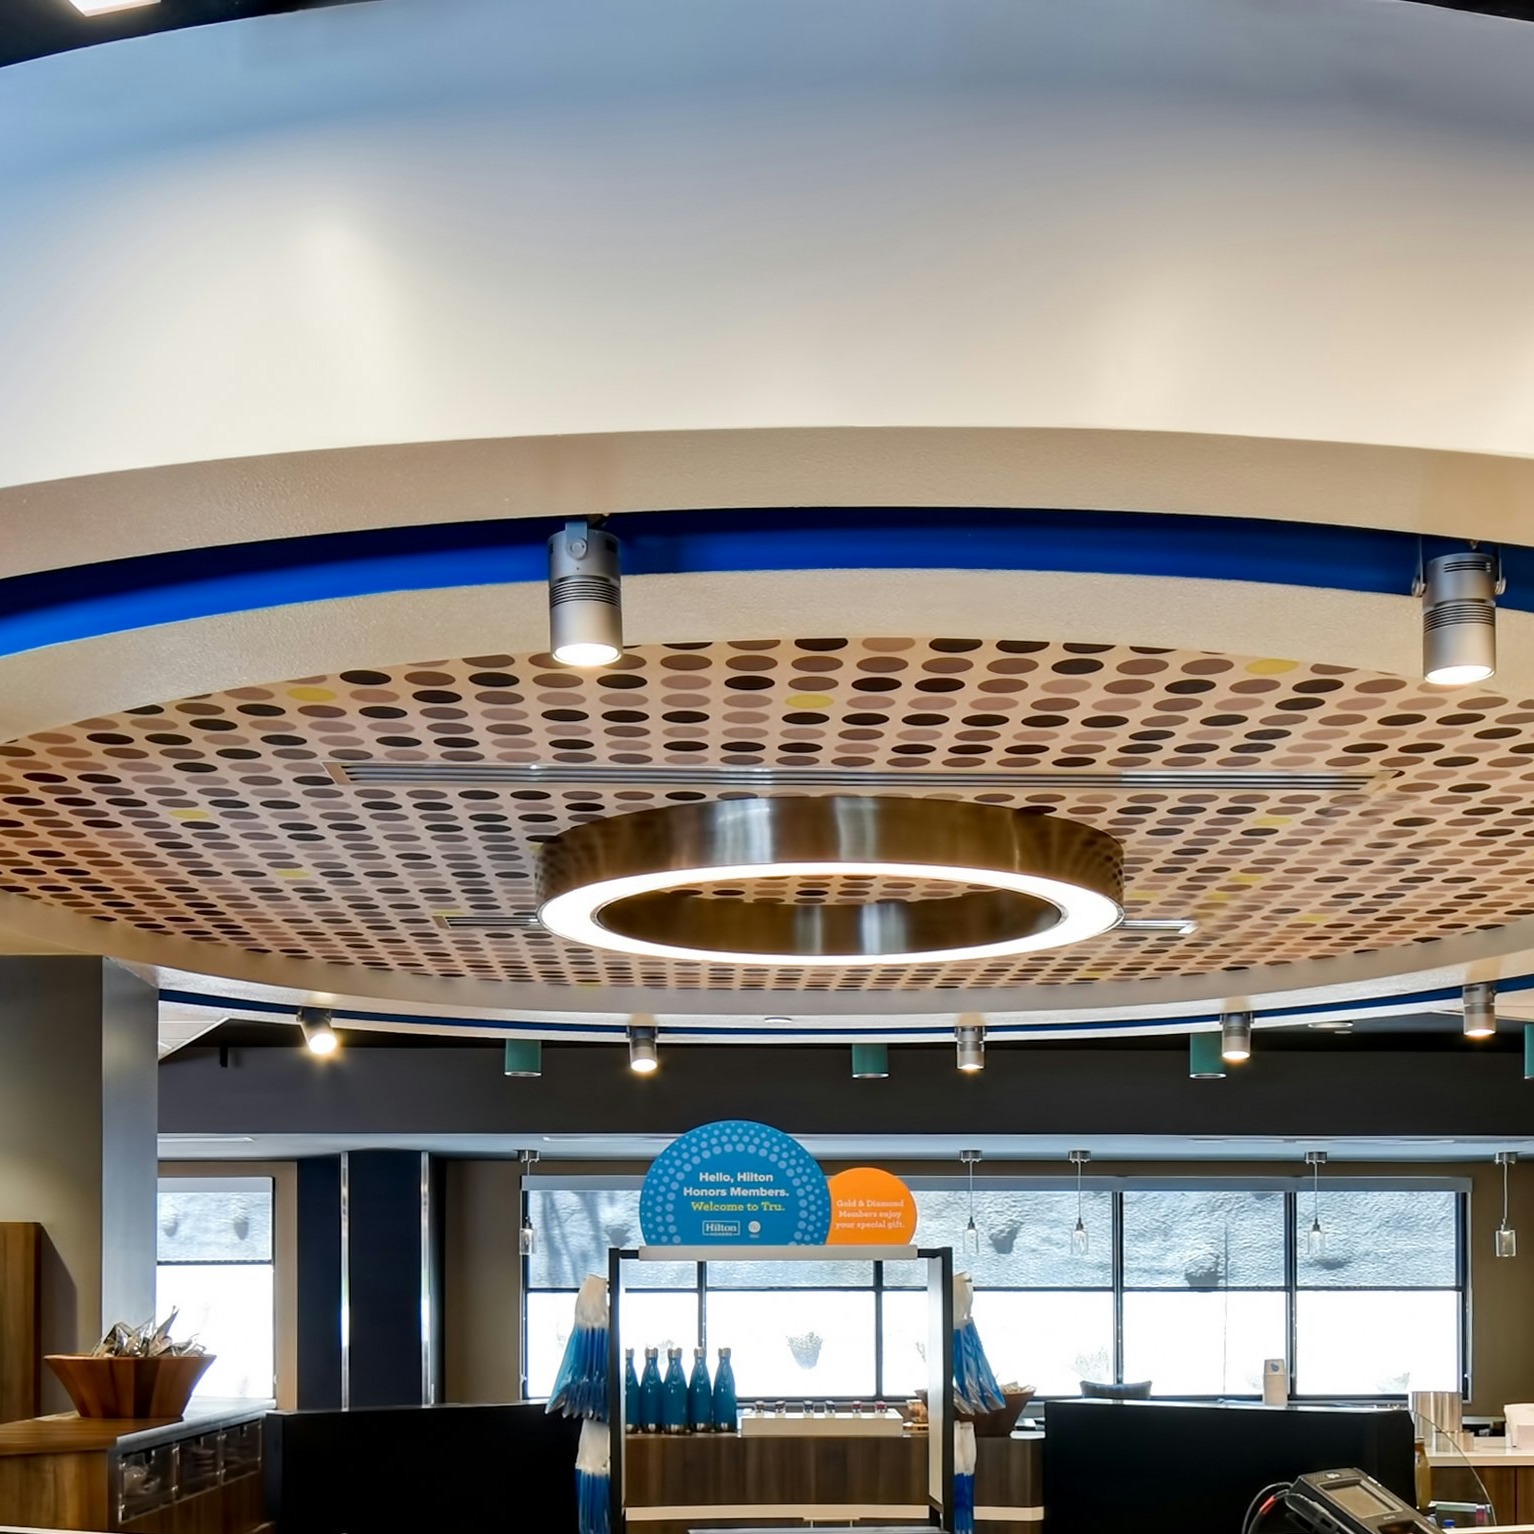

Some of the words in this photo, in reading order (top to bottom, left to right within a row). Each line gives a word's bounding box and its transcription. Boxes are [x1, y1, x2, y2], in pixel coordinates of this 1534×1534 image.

[699, 1172, 734, 1183] Hello,
[737, 1172, 774, 1182] Hilton
[683, 1187, 727, 1197] Honors
[730, 1187, 789, 1197] Members.
[691, 1201, 744, 1212] Welcome
[746, 1203, 759, 1212] to
[761, 1201, 785, 1211] Tru.
[705, 1223, 737, 1233] Hilton
